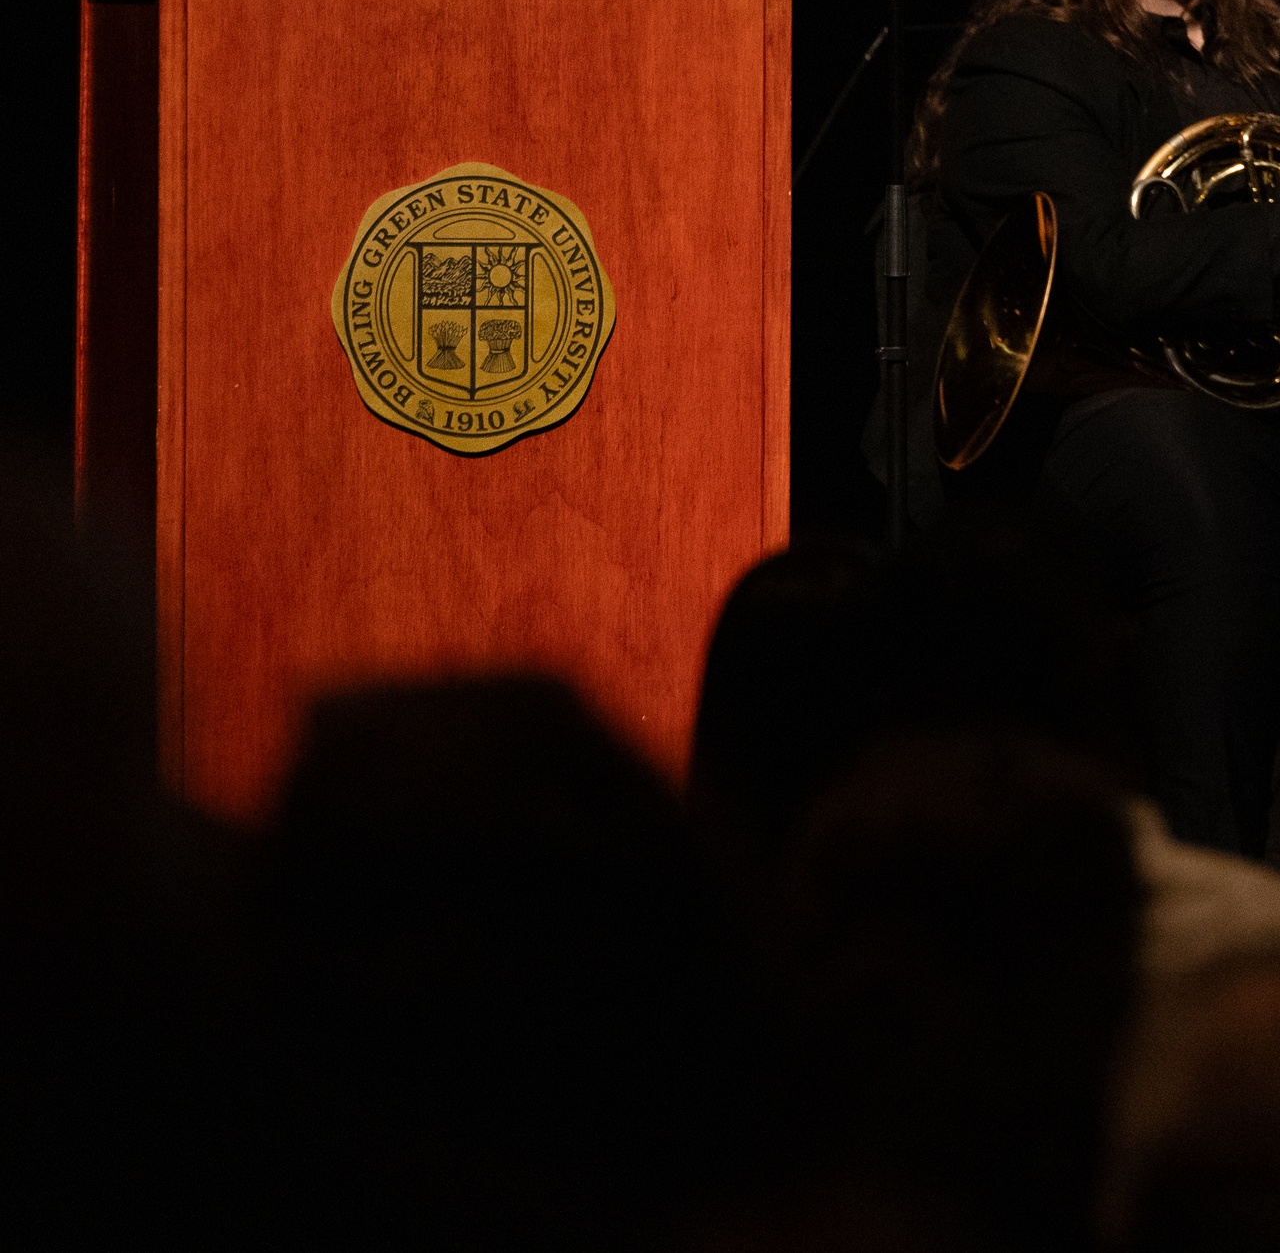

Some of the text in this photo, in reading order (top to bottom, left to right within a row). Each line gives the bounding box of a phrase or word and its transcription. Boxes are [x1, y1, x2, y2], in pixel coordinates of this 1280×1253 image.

[353, 184, 595, 408] BOWLING GREEN STATE UNIVERSITY
[442, 410, 505, 432] 1910
